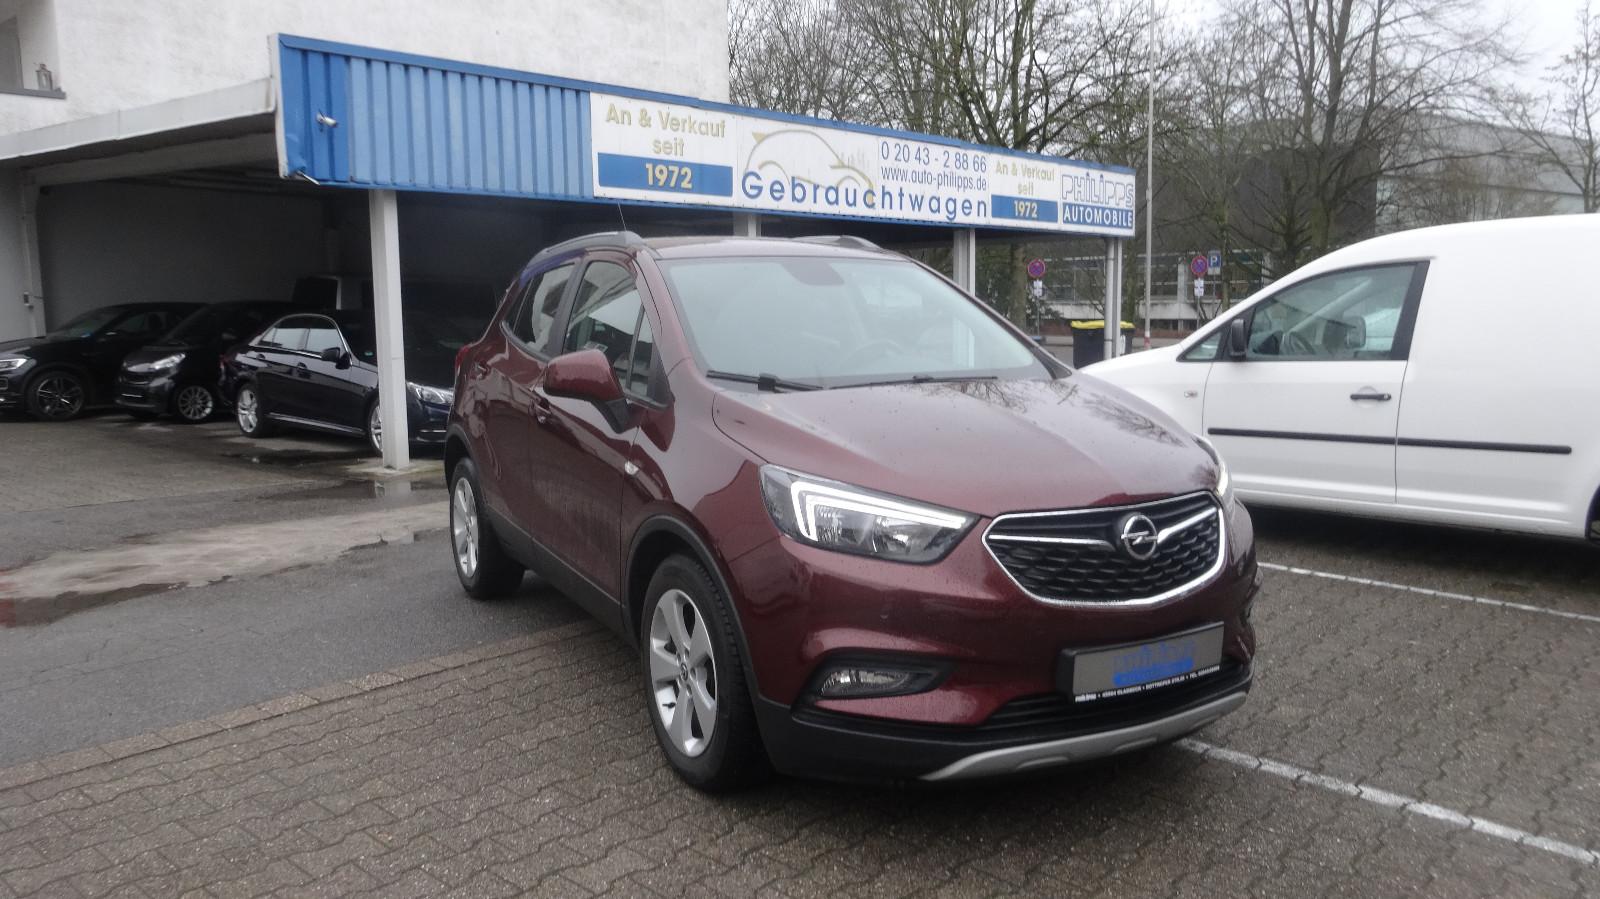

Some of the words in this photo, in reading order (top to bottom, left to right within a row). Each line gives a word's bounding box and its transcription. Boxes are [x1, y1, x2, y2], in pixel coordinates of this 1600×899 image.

[605, 103, 632, 126] An
[638, 110, 652, 128] &
[658, 110, 726, 138] Verkauf
[652, 137, 685, 157] seit
[881, 141, 890, 160] 0
[894, 143, 910, 163] 20
[915, 146, 930, 166] 43
[943, 150, 950, 168] 2
[954, 152, 969, 171] 88
[973, 155, 987, 173] 66
[645, 162, 693, 190] 1972
[881, 165, 987, 192] www.auto-philipps.de
[995, 161, 1008, 175] An
[741, 171, 987, 221] Gebrauchtwagen
[1014, 200, 1038, 218] 1972
[1064, 205, 1133, 227] AUTOMOBILE
[1209, 256, 1218, 266] P
